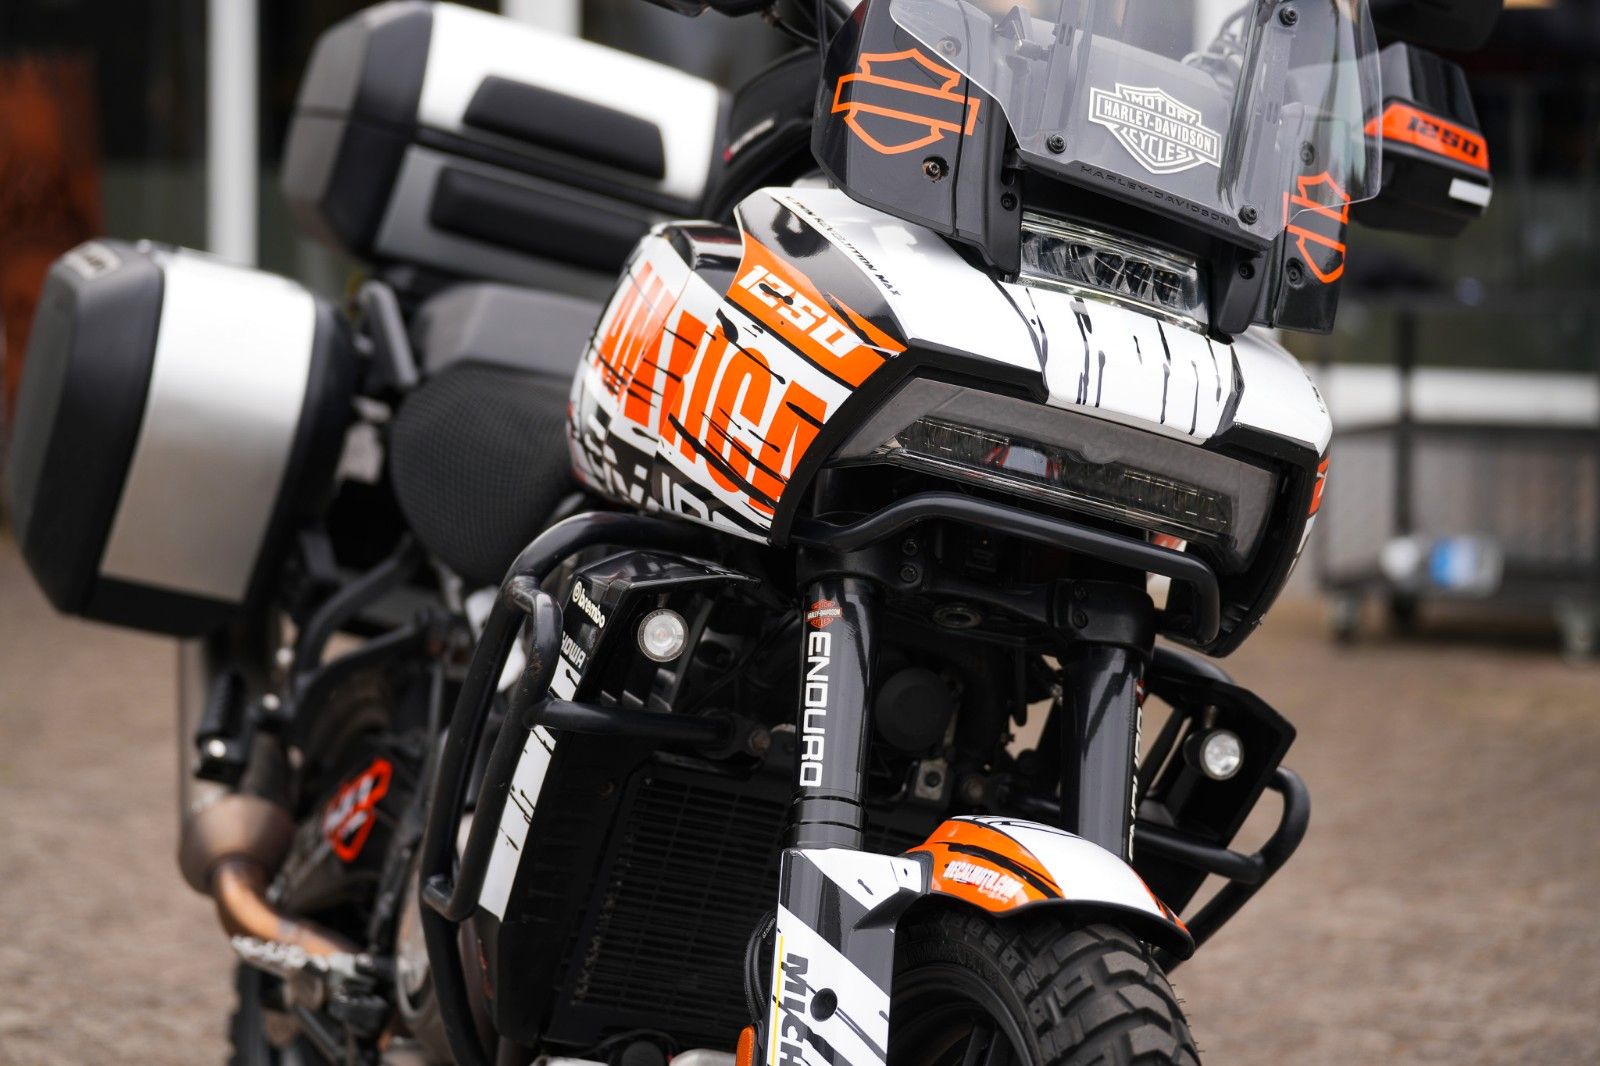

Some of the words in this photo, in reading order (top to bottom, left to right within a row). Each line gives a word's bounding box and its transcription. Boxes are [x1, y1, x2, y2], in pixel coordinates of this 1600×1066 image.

[1103, 99, 1212, 152] HARLEY-DAVIDSON
[1130, 95, 1189, 122] MOTOR
[1128, 128, 1188, 162] CYCLES
[1080, 165, 1231, 226] HARLEY-DAVIDSON
[736, 264, 865, 359] 1250
[578, 587, 606, 629] brembo
[799, 631, 832, 787] ENDURO
[779, 952, 809, 1066] MICH
